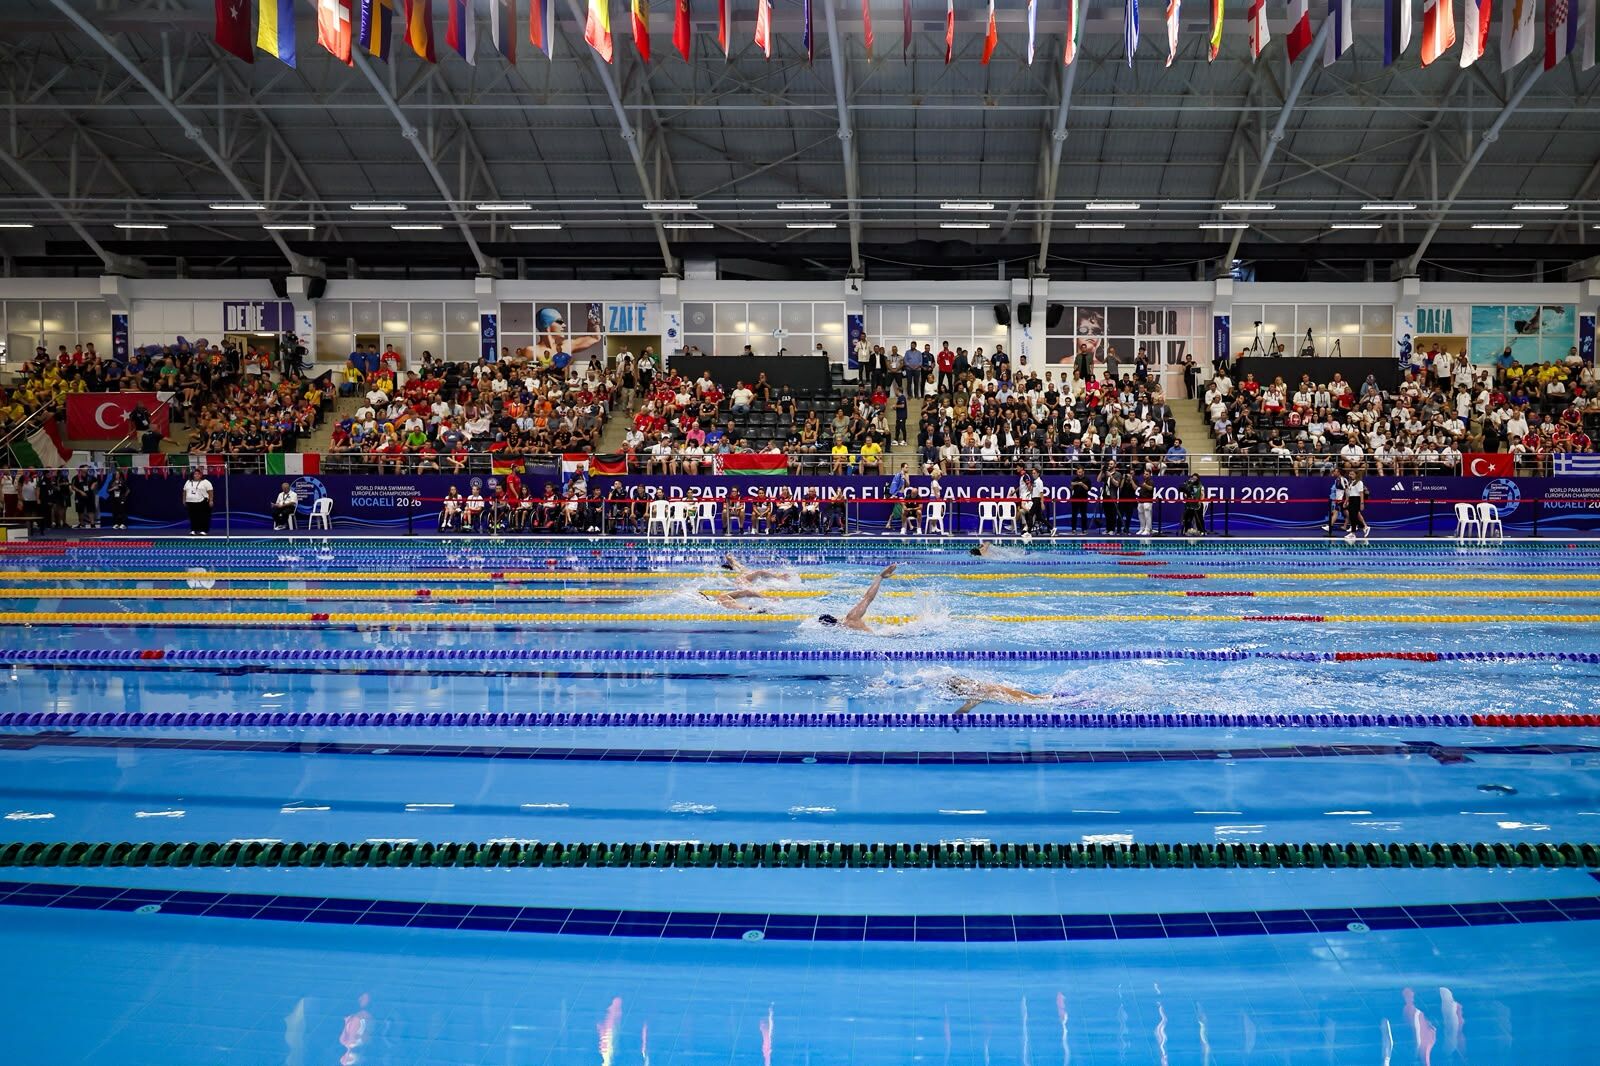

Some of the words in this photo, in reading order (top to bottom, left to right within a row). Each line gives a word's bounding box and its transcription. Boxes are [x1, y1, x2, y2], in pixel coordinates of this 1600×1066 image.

[1137, 310, 1177, 335] SPOR
[351, 496, 394, 507] KOCAELİ
[396, 498, 422, 507] 2026
[1241, 486, 1289, 503] 2026
